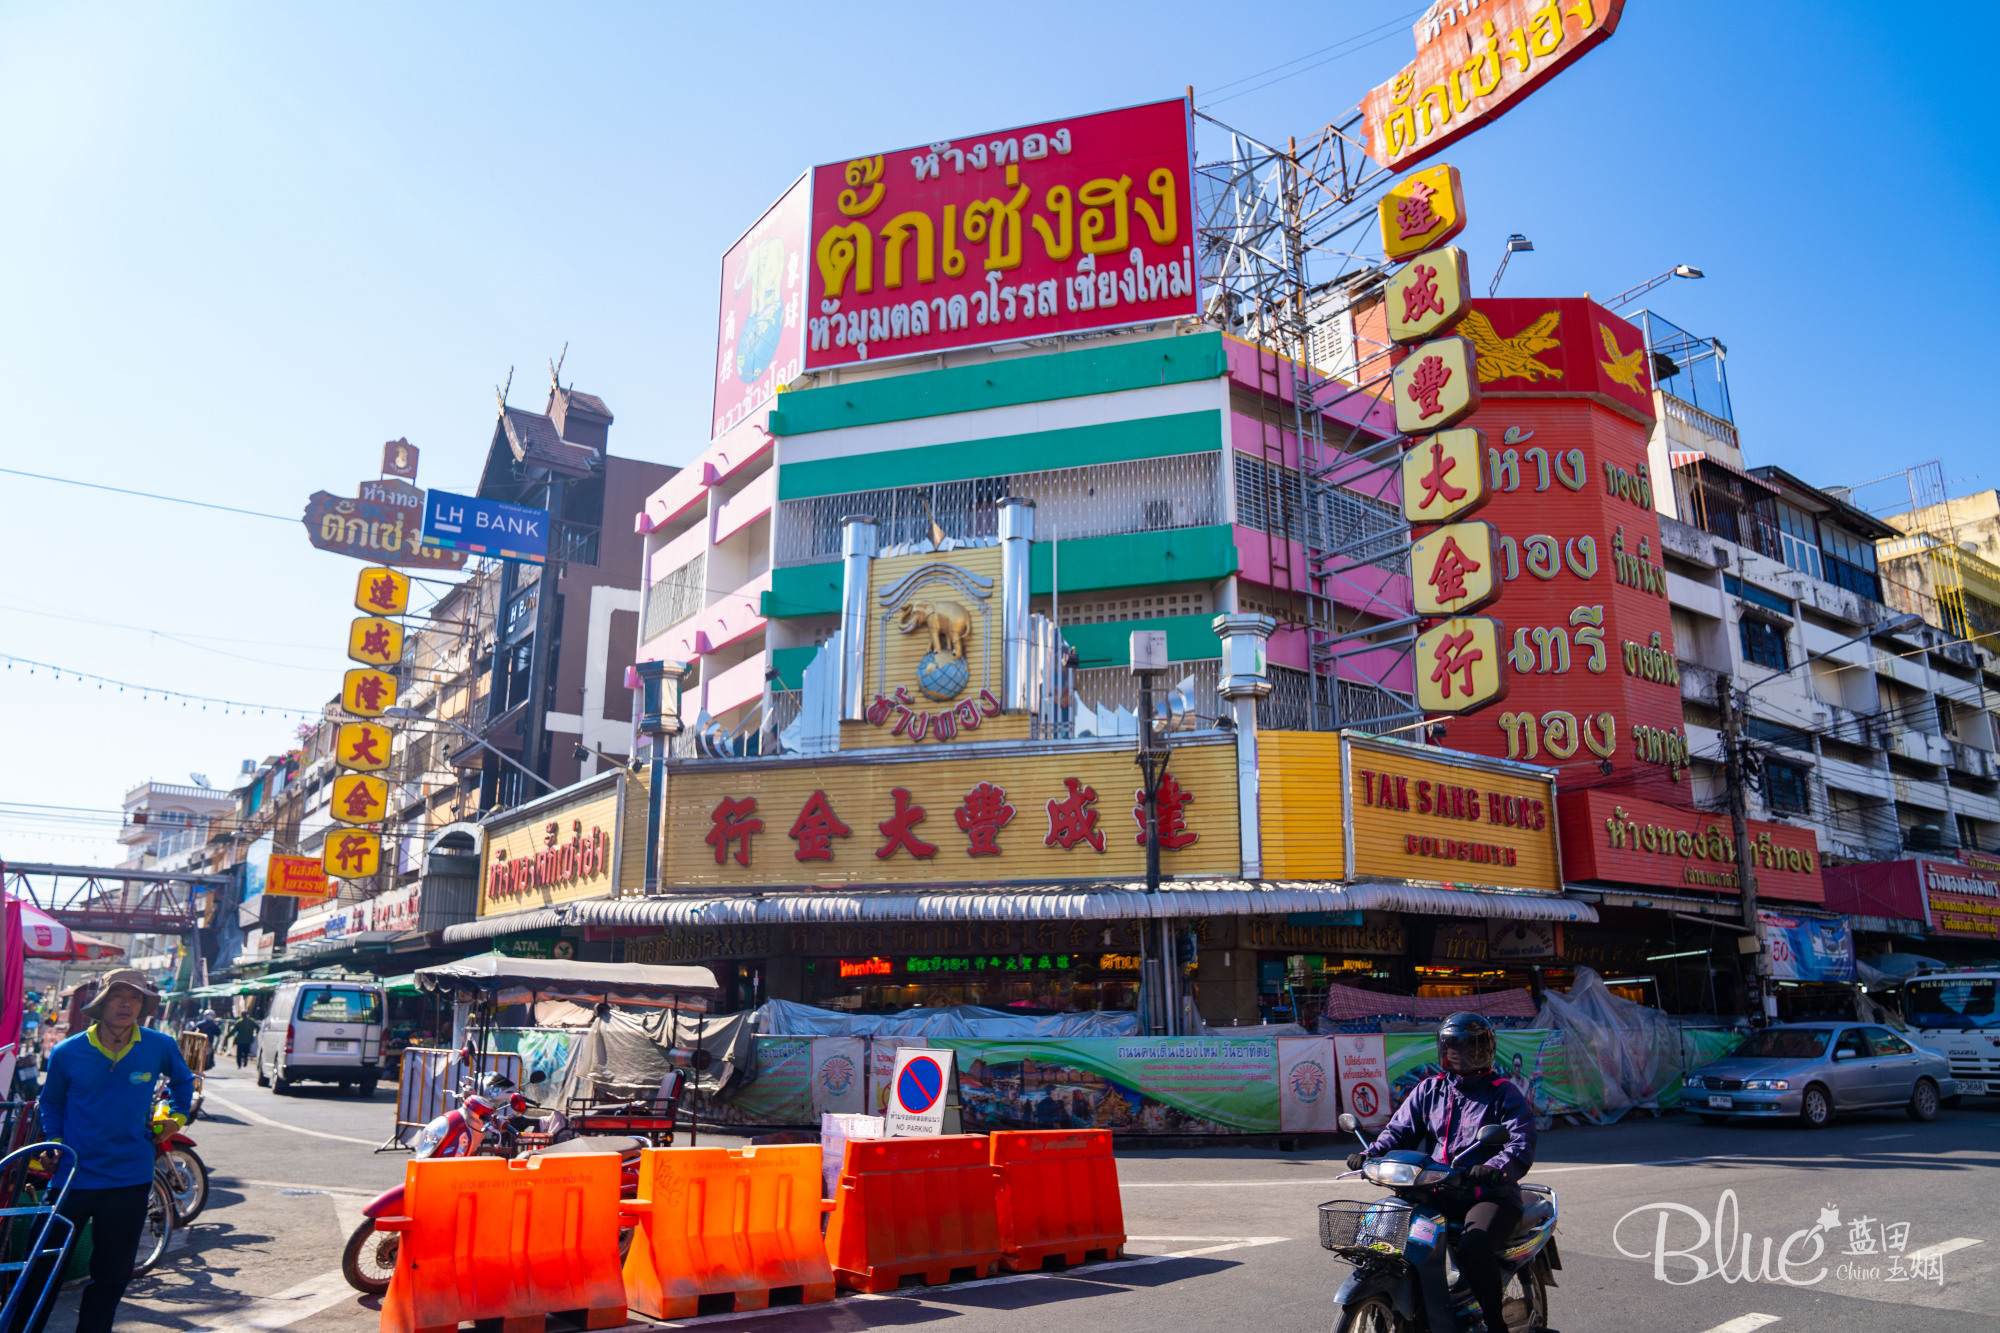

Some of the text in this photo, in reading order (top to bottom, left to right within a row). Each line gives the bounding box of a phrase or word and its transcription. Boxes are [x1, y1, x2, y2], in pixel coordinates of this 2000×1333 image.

[911, 126, 1072, 182] ห้างทอง
[816, 153, 1179, 299] ตั๊กเซ่งฮง
[808, 246, 1193, 360] หัวมุมตลาดวโรรส เชียงใหม่
[364, 483, 426, 508] ห้างทอ
[435, 504, 539, 537] LH BANK
[321, 500, 460, 562] ตั๊กเซ่ง
[866, 686, 1001, 742] ห้างทอง
[1498, 710, 1616, 760] ทอง
[1362, 770, 1546, 831] TAK SANG HONG
[1407, 834, 1517, 866] GOLDSMITH
[513, 940, 539, 952] ATM
[1117, 1040, 1271, 1059] ถนนคนเดินเชียงใหม่ วันอาทิตย์
[895, 1123, 933, 1133] NO PARKING
